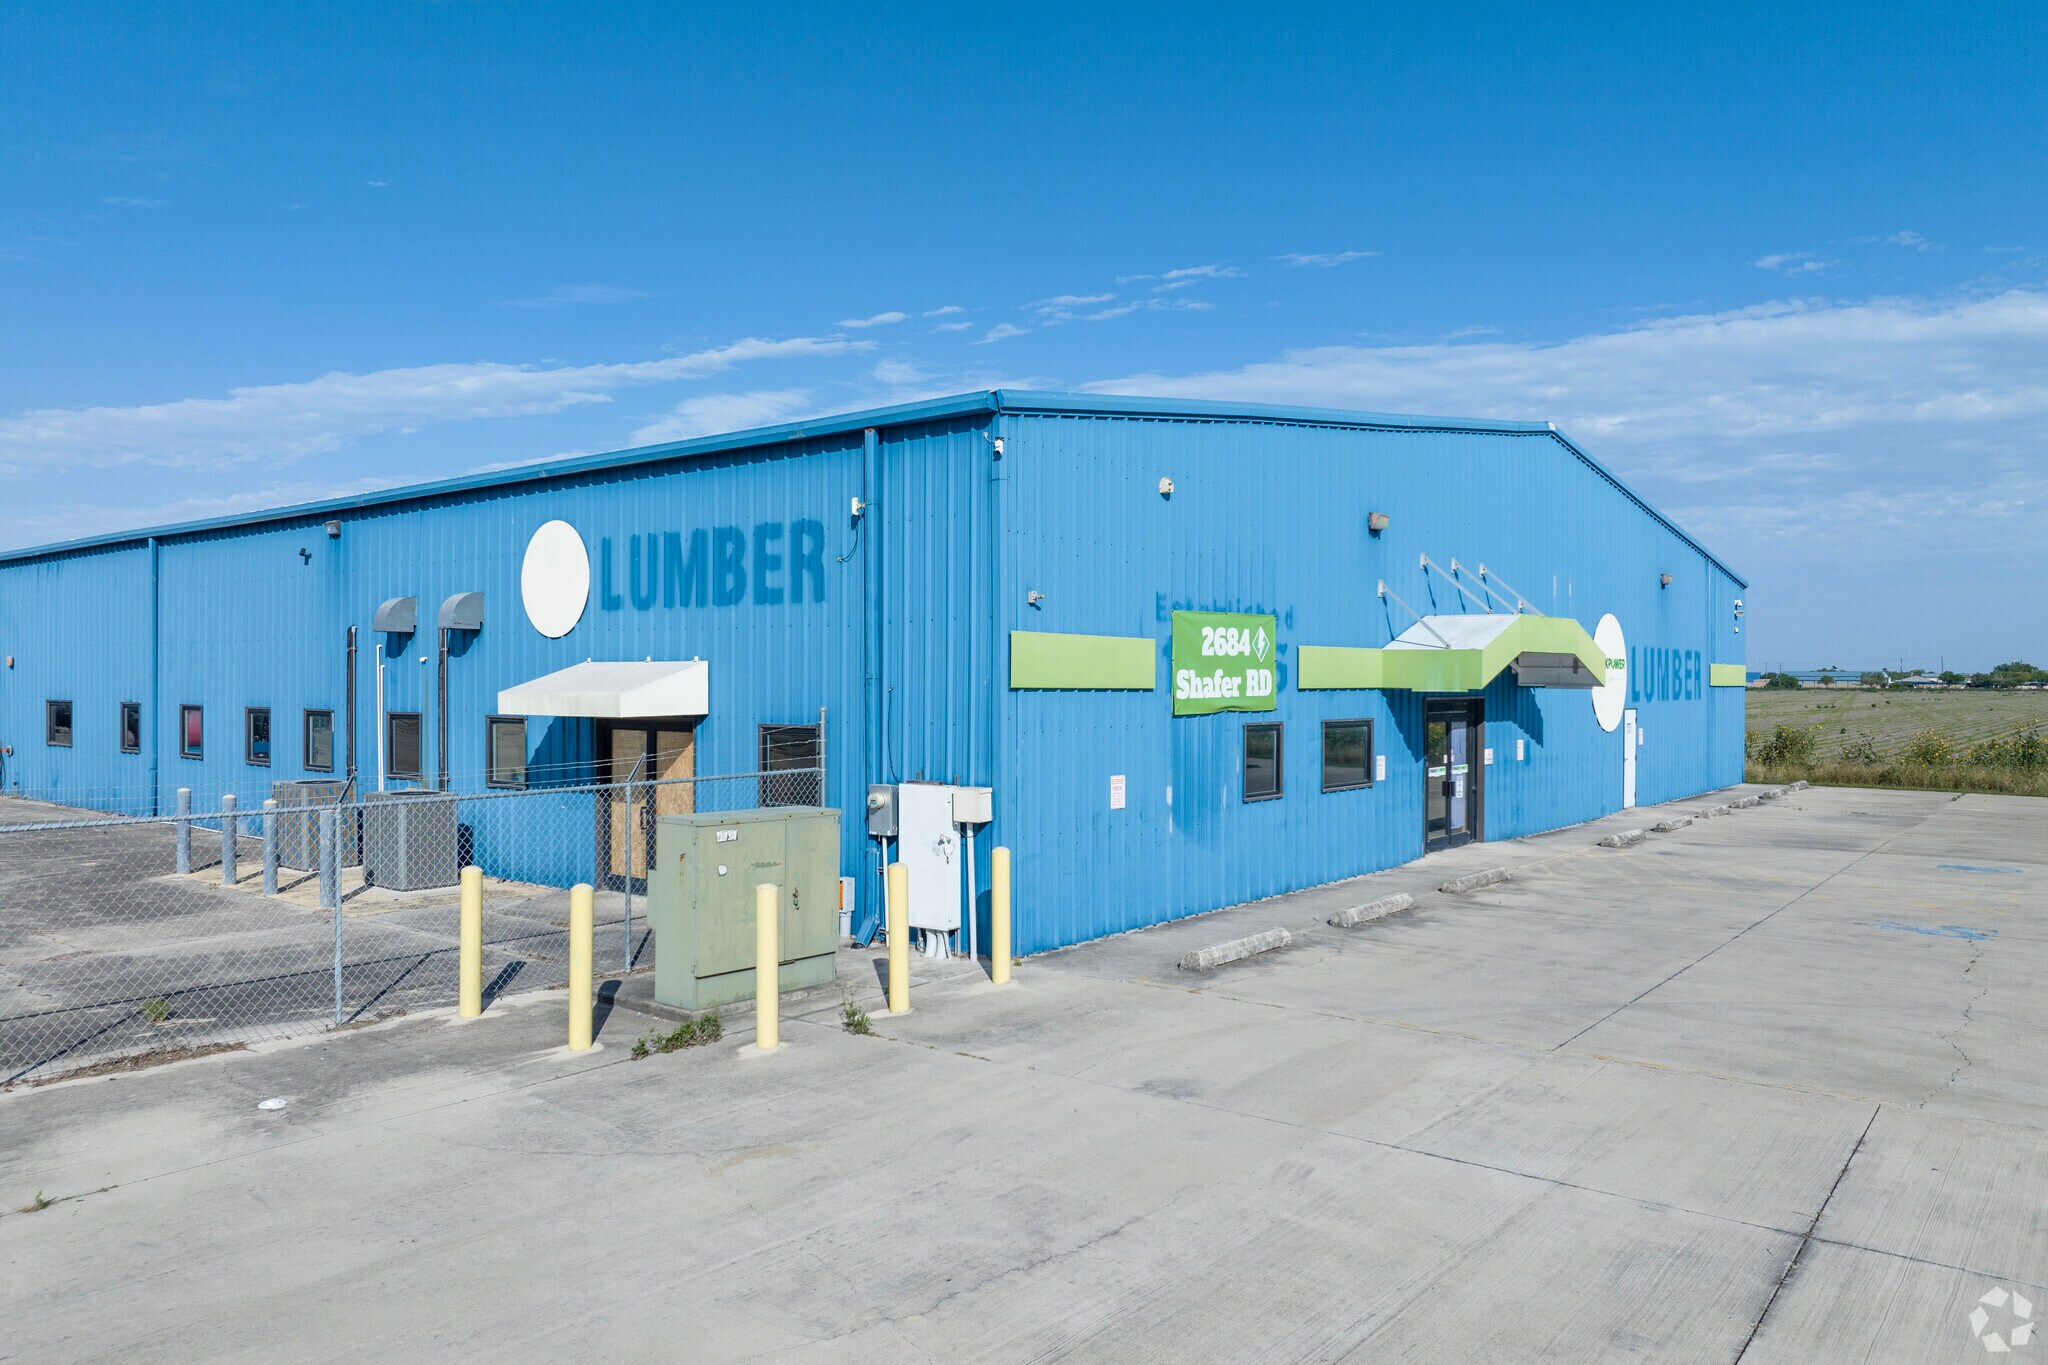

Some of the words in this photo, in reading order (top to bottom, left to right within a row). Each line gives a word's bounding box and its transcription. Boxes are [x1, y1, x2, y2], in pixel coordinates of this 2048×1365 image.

[601, 518, 826, 611] LUMBER
[1201, 626, 1251, 657] 2684
[1176, 668, 1242, 700] Shafer
[1245, 668, 1273, 697] RD
[1631, 645, 1702, 703] LUMBER
